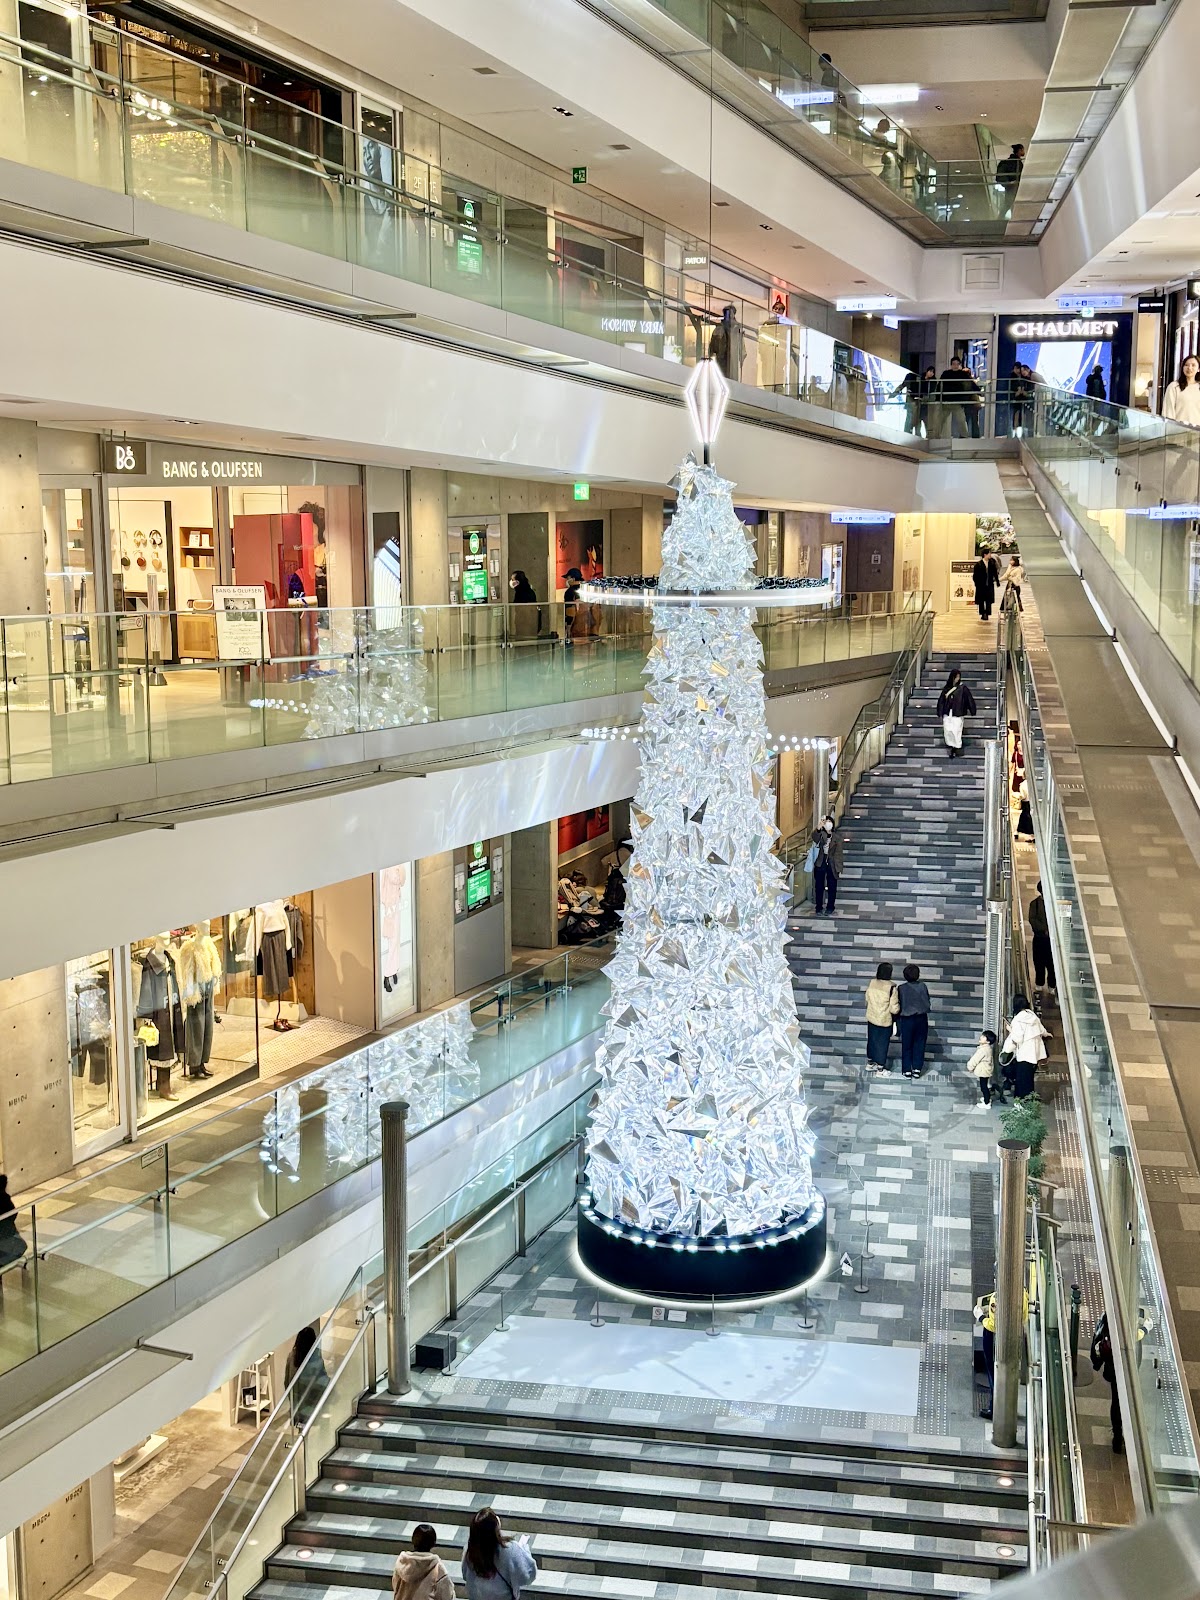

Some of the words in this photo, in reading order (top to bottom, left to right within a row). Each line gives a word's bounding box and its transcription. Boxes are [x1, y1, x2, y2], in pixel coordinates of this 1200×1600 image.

[413, 176, 422, 189] 2F
[684, 256, 706, 265] PATOU
[1011, 320, 1119, 336] CHAUMET
[162, 461, 198, 478] BANG
[201, 461, 209, 478] &
[211, 461, 263, 478] OLUFSEN
